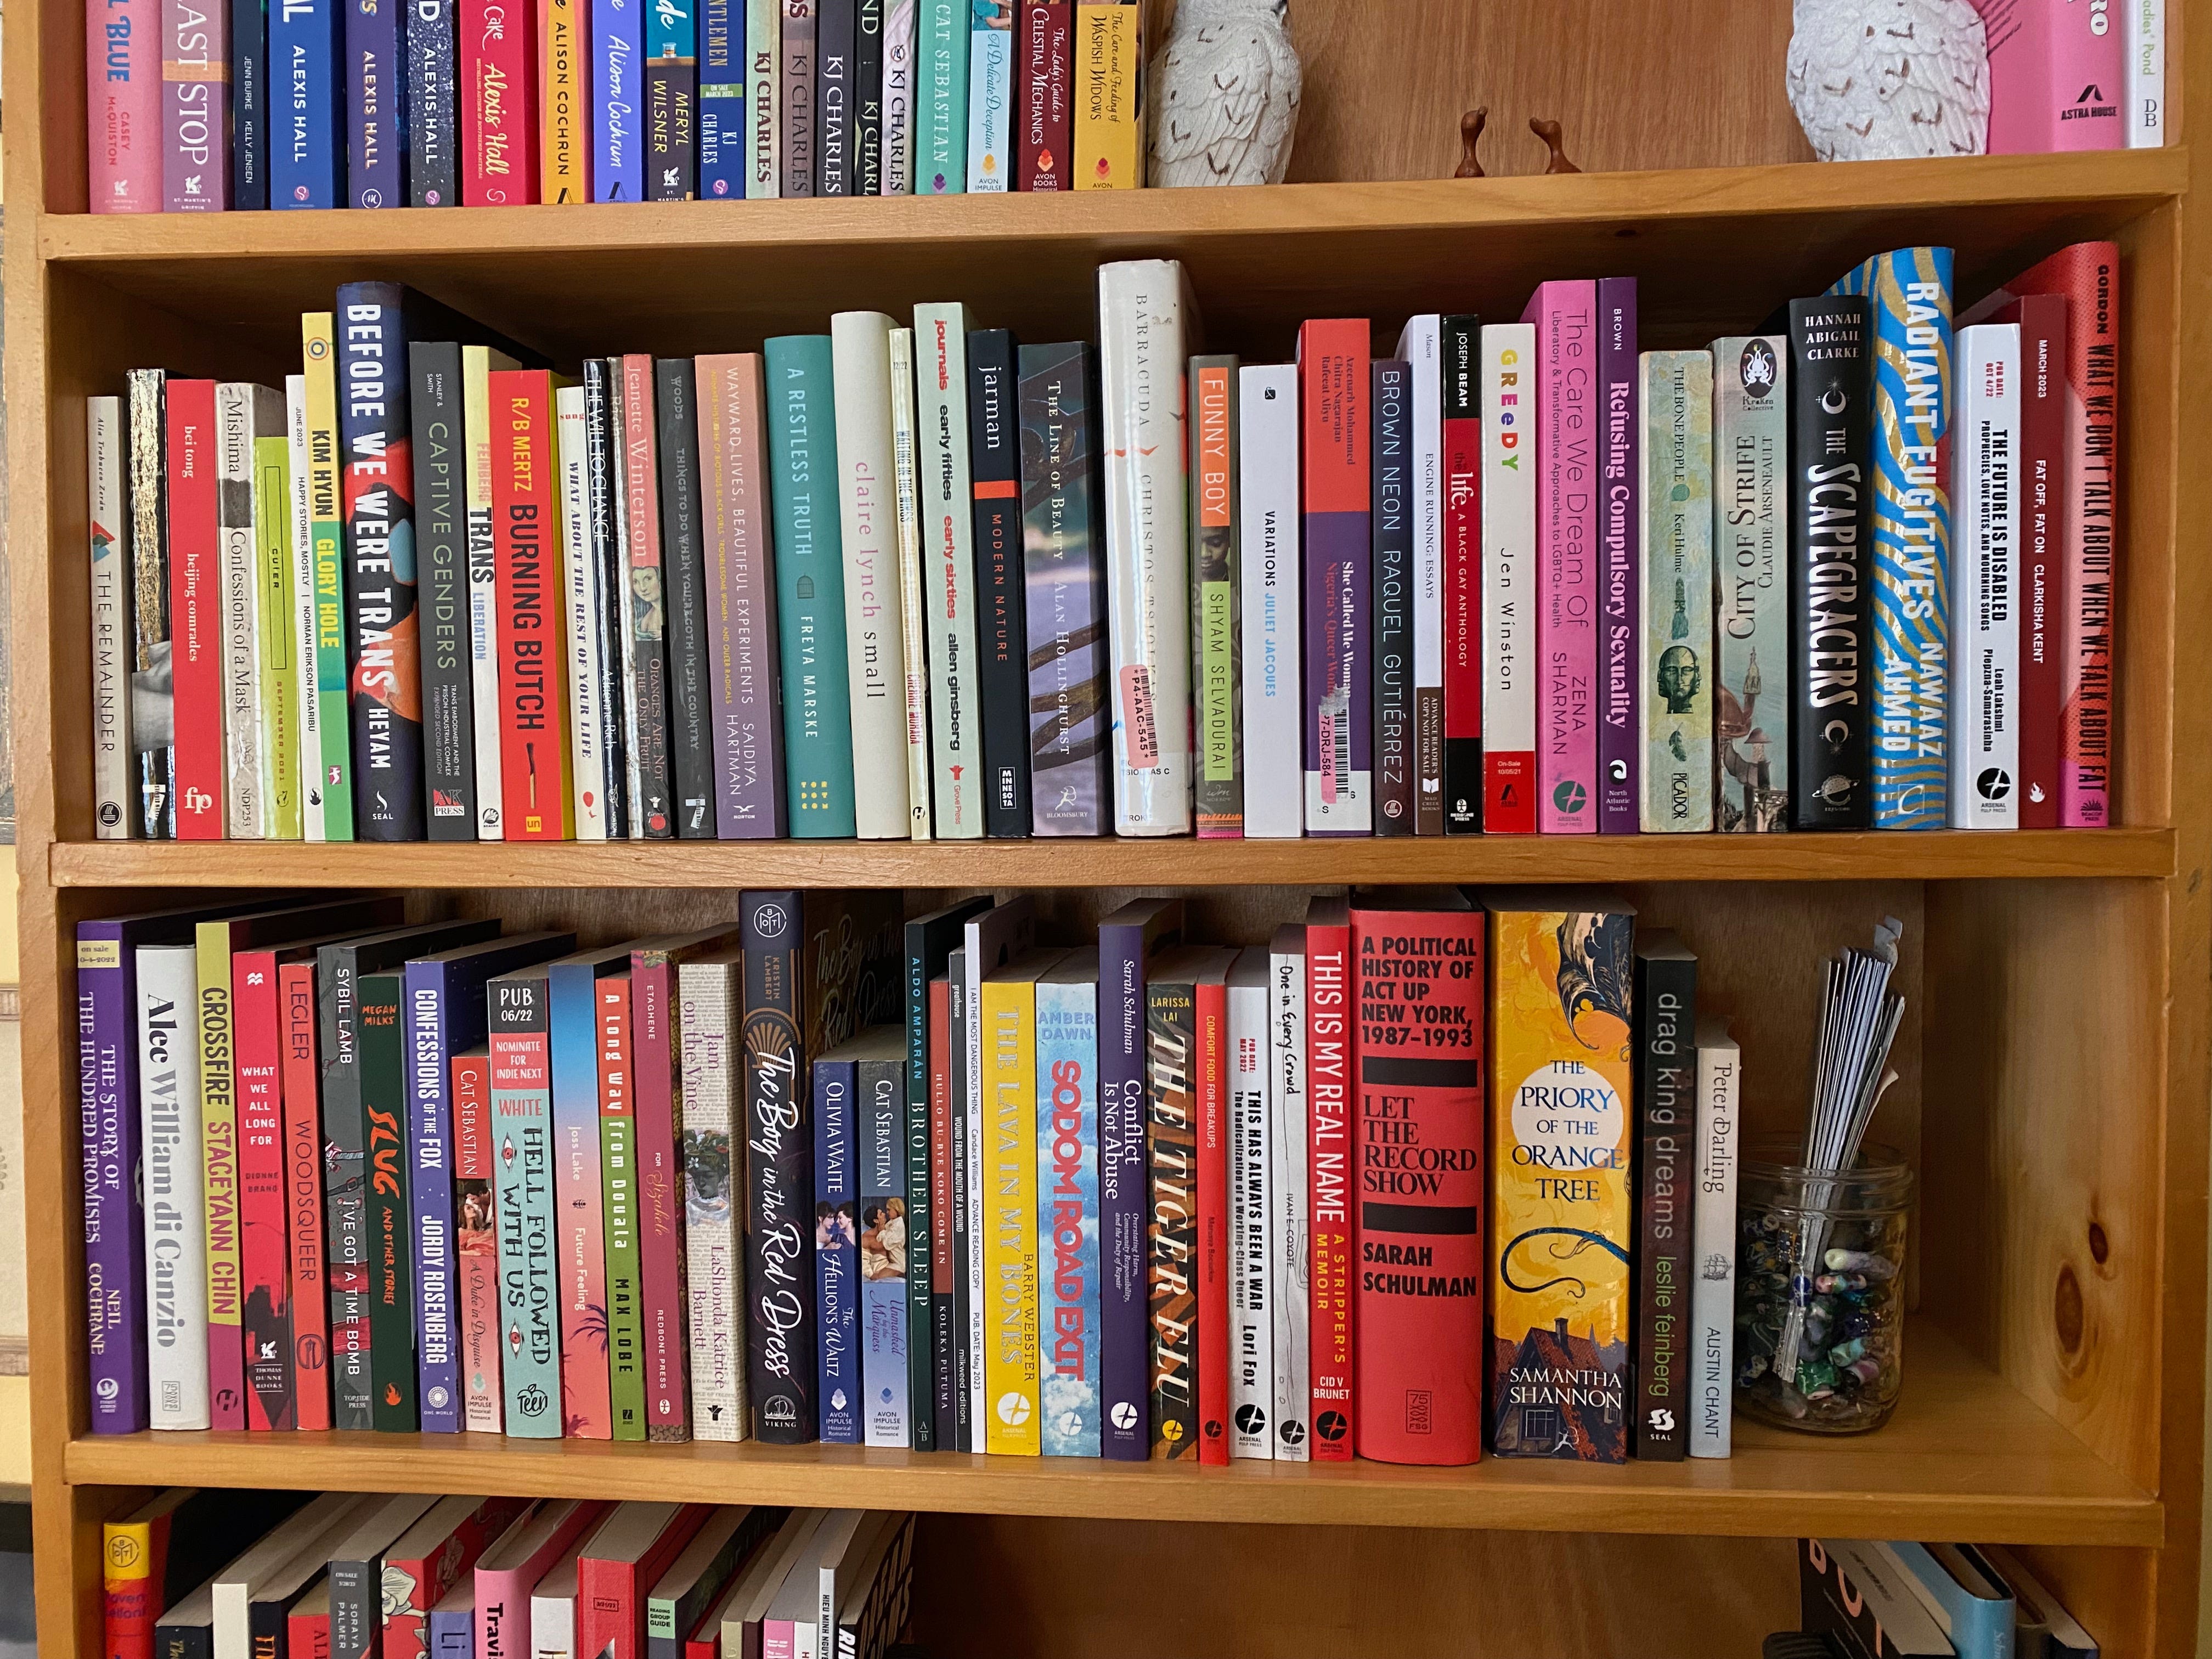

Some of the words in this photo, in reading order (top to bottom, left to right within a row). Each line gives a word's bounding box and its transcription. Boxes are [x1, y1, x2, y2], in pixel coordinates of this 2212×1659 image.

[936, 5, 950, 40] CAT
[106, 16, 131, 82] BLUE
[556, 22, 568, 83] ALISON
[754, 51, 771, 74] KJ
[823, 55, 843, 80] KJ
[2143, 44, 2155, 75] Pond
[293, 46, 305, 109] ALEXIS
[121, 112, 129, 150] CASEY
[178, 83, 208, 165] STOP
[653, 81, 667, 153] WILSNER
[675, 92, 688, 146] MERYL
[757, 81, 771, 182] CHARLES
[934, 49, 950, 163] SEBASTIAN
[2061, 108, 2089, 120] ASTRA
[2092, 106, 2117, 117] HOUSE
[295, 116, 306, 162] HALL
[557, 93, 569, 174] COCHRUN
[825, 86, 843, 193] CHARLES
[1614, 308, 1622, 351] BROWN
[1805, 314, 1861, 326] HANNAH
[1806, 331, 1860, 343] ABIGAIL
[347, 304, 385, 417] BEFORE
[788, 369, 804, 378] A
[934, 320, 948, 391] journals
[1808, 347, 1860, 360] CLARKE
[1905, 282, 1939, 428] RADIANT
[2038, 340, 2048, 375] MARCH
[978, 365, 1002, 449] jarman
[1382, 371, 1400, 455] BROWN
[2038, 377, 2046, 398] 2023
[788, 391, 809, 482] RESTLESS
[940, 405, 951, 449] early
[1204, 380, 1223, 457] FUNNY
[1605, 381, 1629, 478] Refusing
[312, 430, 330, 462] KIM
[353, 431, 386, 476] WE
[314, 470, 332, 516] HYUN
[429, 422, 451, 534] CAPTIVE
[856, 462, 875, 535] claire
[941, 454, 952, 501] fifties
[1205, 473, 1225, 515] BOY
[1383, 468, 1400, 531] NEON
[355, 490, 390, 573] WERE
[793, 493, 812, 554] TRUTH
[1902, 445, 1937, 619] FUGITIVES
[184, 553, 200, 600] beijing
[509, 504, 542, 629] BURNING
[1500, 548, 1514, 588] Jen
[1605, 485, 1630, 618] Compulsory
[98, 572, 111, 611] THE
[433, 544, 456, 669] GENDERS
[856, 549, 882, 618] lynch
[1383, 550, 1402, 642] RAQUEL
[2033, 564, 2045, 634] CLARKISHA
[189, 600, 201, 662] comrades
[358, 587, 394, 686] TRANS
[801, 616, 815, 665] FREYA
[949, 633, 957, 672] allen
[1500, 602, 1515, 690] Winston
[2033, 636, 2044, 664] KENT
[99, 624, 114, 751] REMAINDER
[514, 641, 544, 730] BUTCH
[864, 633, 885, 698] small
[1606, 625, 1630, 729] Sexuality
[803, 675, 817, 737] MARSKE
[947, 676, 961, 751] ginsberg
[1384, 654, 1407, 785] GUTIÉRREZ
[727, 715, 741, 795] HARTMAN
[743, 723, 756, 786] SAIDIYA
[1673, 772, 1688, 820] PICADOR
[337, 968, 350, 1014] SYBIL
[500, 988, 533, 1007] PUB
[1124, 959, 1135, 995] Sarah
[1152, 997, 1190, 1008] LARISSA
[1279, 966, 1294, 990] One
[1282, 995, 1291, 1006] in
[147, 993, 178, 1063] Alec
[290, 980, 309, 1060] LEGLER
[501, 1009, 533, 1022] 06/22
[647, 985, 655, 1040] ETAGHENE
[1124, 996, 1135, 1054] Schulman
[1163, 1012, 1177, 1022] LAI
[1276, 1012, 1297, 1049] Every
[201, 988, 230, 1106] CROSSFIRE
[339, 1019, 353, 1064] LAMB
[242, 1067, 275, 1077] WHAT
[250, 1084, 268, 1093] WE
[460, 1070, 478, 1098] CAT
[1285, 1054, 1301, 1095] Crowd
[150, 1069, 181, 1195] William
[245, 1119, 275, 1128] LONG
[249, 1102, 270, 1111] ALL
[826, 1082, 845, 1139] OLIVIA
[251, 1136, 272, 1146] FOR
[461, 1101, 478, 1175] SEBASTIAN
[826, 1141, 844, 1193] WAITE
[154, 1201, 183, 1232] di
[422, 1215, 445, 1267] JORDY
[1024, 1254, 1034, 1302] BARRY
[1363, 1242, 1433, 1266] SARAH
[154, 1239, 185, 1347] Canzio
[212, 1261, 235, 1315] CHIN
[1363, 1272, 1476, 1296] SCHULMAN
[1656, 1256, 1677, 1308] leslie
[422, 1271, 448, 1364] ROSENBERG
[657, 1310, 665, 1355] REDBONE
[1024, 1308, 1035, 1381] WEBSTER
[1649, 1313, 1677, 1397] feinberg
[1706, 1327, 1720, 1381] AUSTIN
[1313, 1389, 1350, 1400] BRUNET
[1320, 1376, 1335, 1387] CID
[1336, 1377, 1343, 1387] V
[1510, 1367, 1622, 1389] SAMANTHA
[1510, 1387, 1622, 1410] SHANNON
[1705, 1387, 1720, 1438] CHANT
[337, 1601, 346, 1649] PALMER
[350, 1603, 358, 1649] SORAYA
